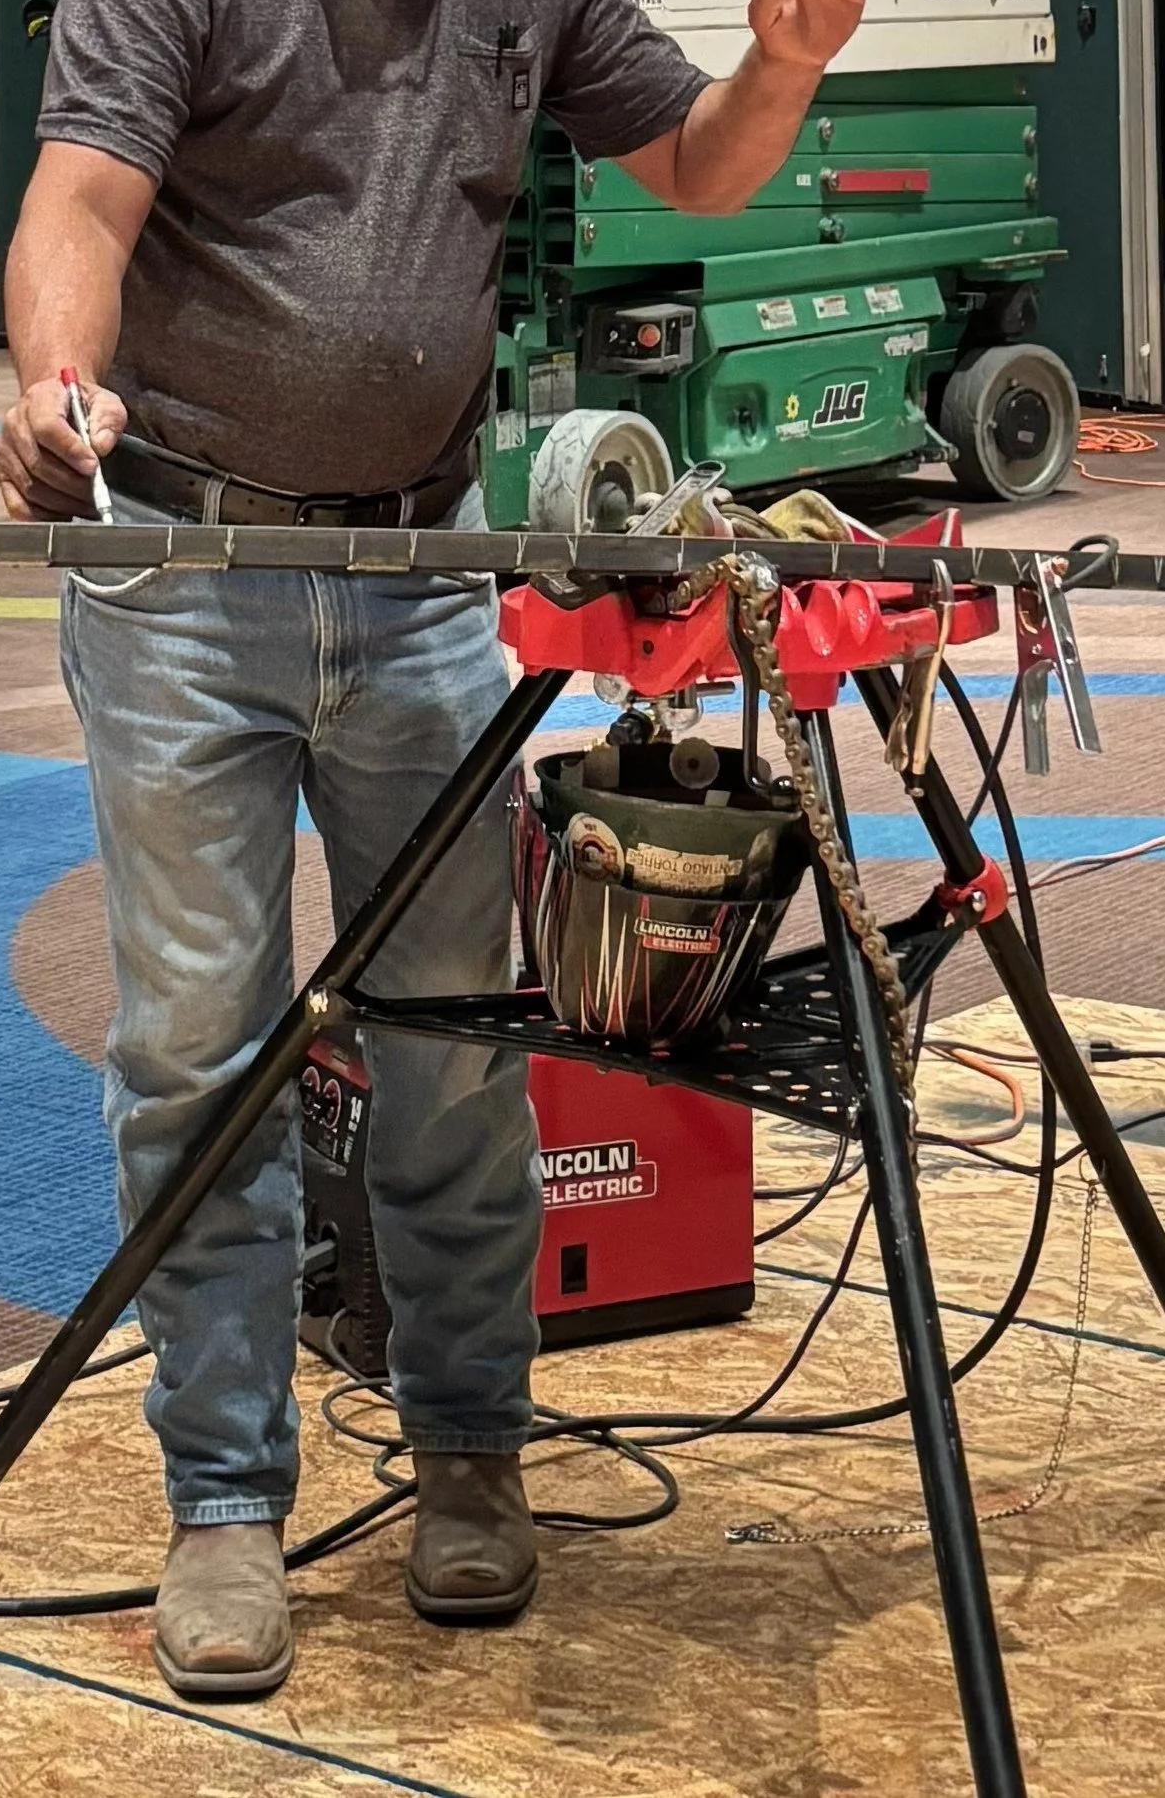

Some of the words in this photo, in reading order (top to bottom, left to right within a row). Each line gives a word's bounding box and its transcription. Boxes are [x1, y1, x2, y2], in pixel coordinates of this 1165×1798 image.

[812, 380, 869, 428] JLG
[639, 920, 708, 940] LINCOLN
[652, 937, 712, 951] ELECTRIC
[540, 1146, 629, 1179] NCOLN
[542, 1175, 643, 1204] ELECTRIC
